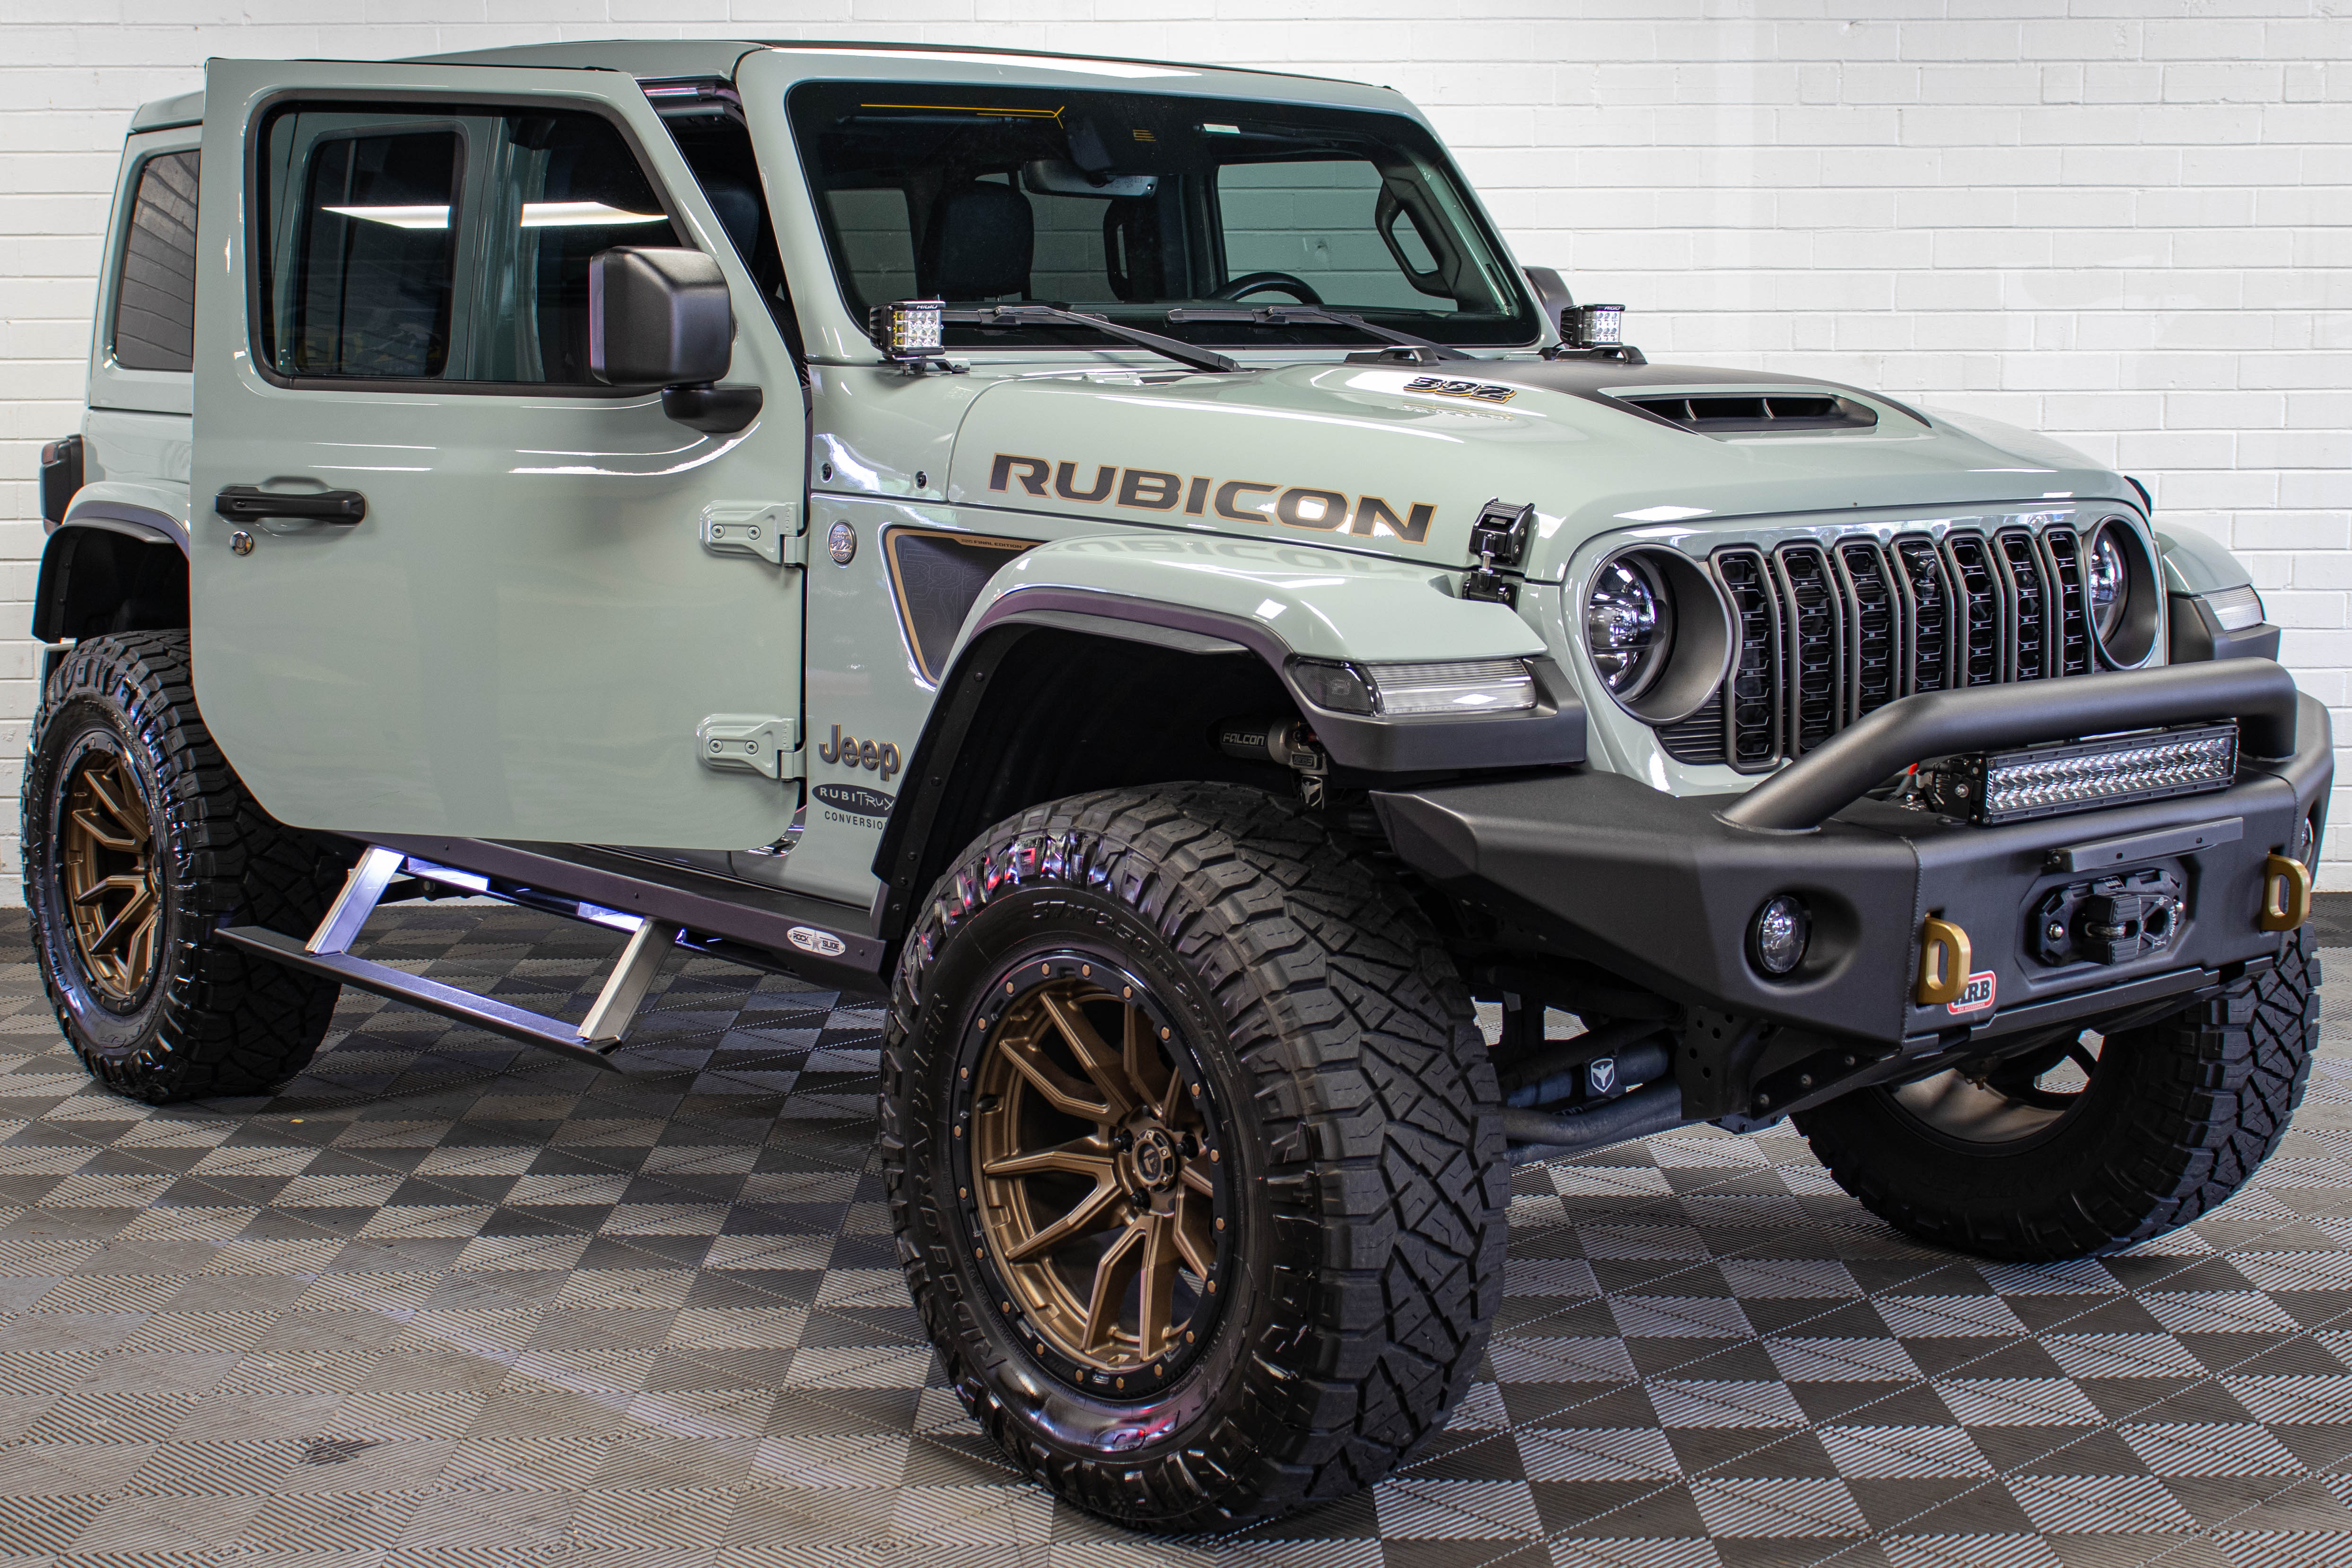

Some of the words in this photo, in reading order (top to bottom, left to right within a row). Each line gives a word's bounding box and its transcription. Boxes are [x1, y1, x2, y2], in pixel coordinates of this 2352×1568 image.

[1403, 377, 1517, 403] 392
[988, 452, 1438, 545] RUBICON
[819, 723, 901, 781] Jeep
[1223, 733, 1265, 745] FALCON
[1986, 770, 1994, 809] RIGID
[825, 811, 887, 830] CONVERSIO
[793, 933, 809, 943] ROCK
[822, 940, 839, 951] SLIDE
